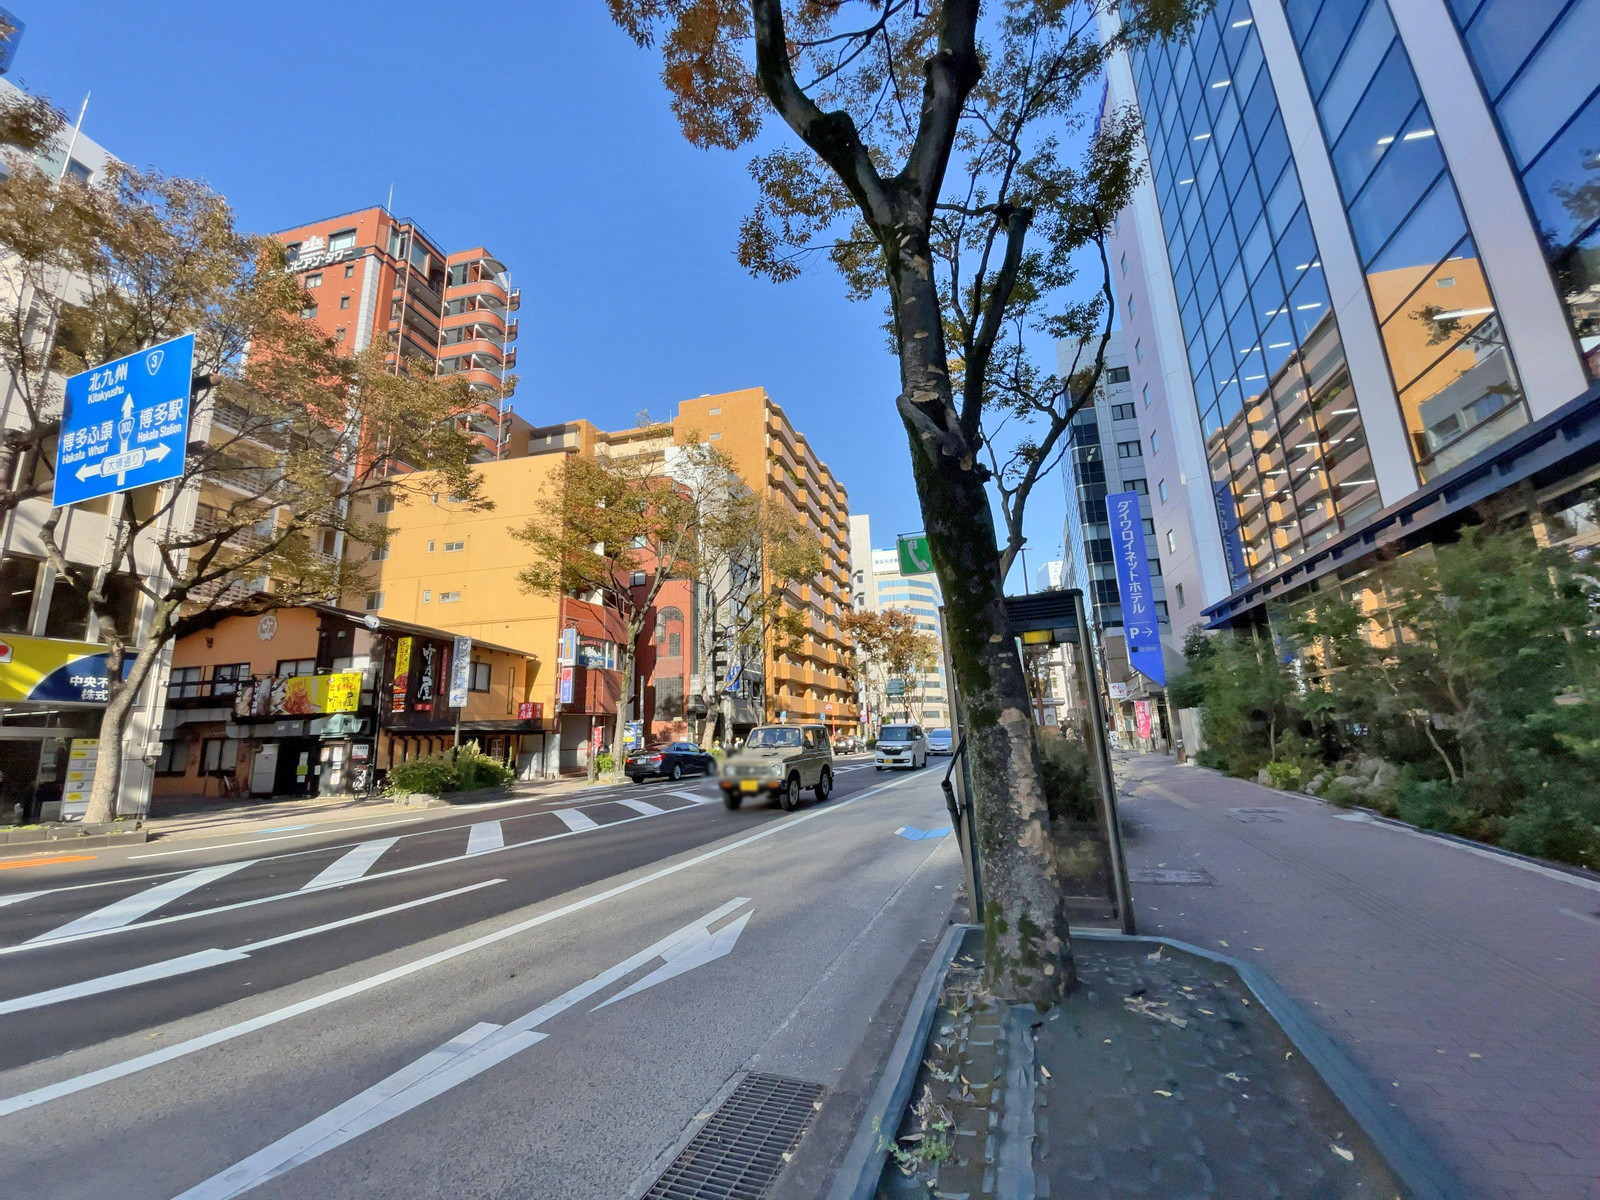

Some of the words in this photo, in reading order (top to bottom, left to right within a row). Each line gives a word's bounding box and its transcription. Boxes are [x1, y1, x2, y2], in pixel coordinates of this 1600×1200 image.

[151, 354, 158, 369] 3
[88, 361, 128, 392] 北九州
[87, 385, 125, 405] Kitakyushu
[139, 399, 184, 431] 博多駅
[62, 420, 114, 453] 博多ふ頭
[121, 420, 131, 434] 202
[137, 428, 159, 443] Hakata
[159, 423, 182, 439] Station
[62, 449, 86, 465] Hakata
[87, 442, 110, 457] Wharf
[107, 454, 141, 472] 大博通り
[1116, 499, 1145, 615] ダイワロイネットホテル
[1130, 627, 1139, 639] P
[69, 675, 109, 688] 中央不
[81, 689, 109, 701] 株式
